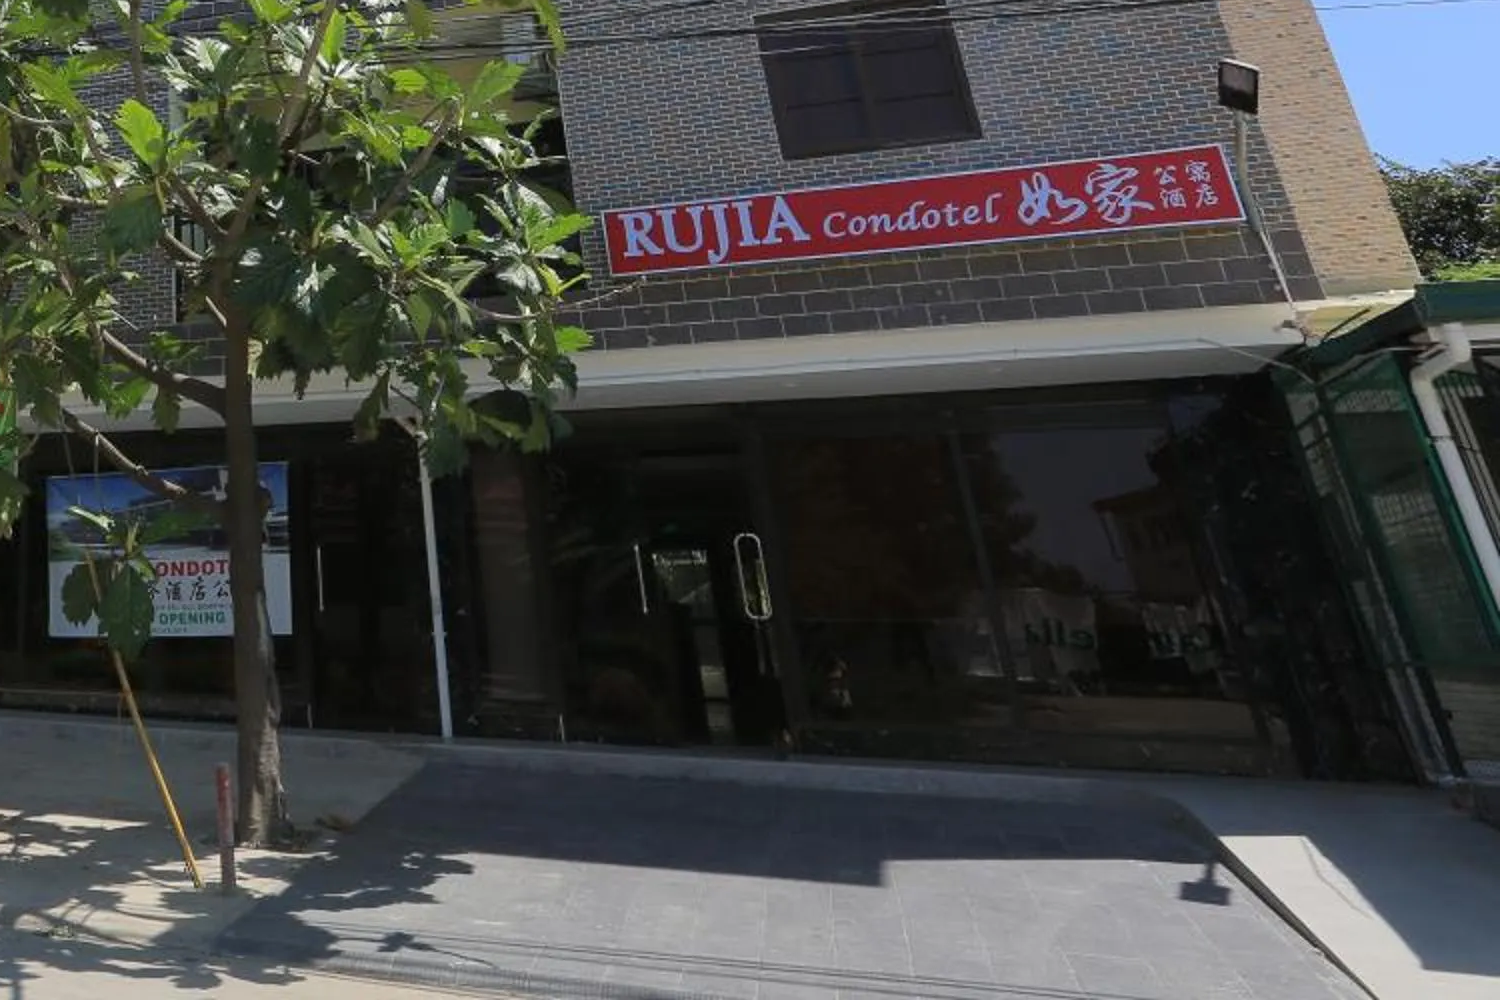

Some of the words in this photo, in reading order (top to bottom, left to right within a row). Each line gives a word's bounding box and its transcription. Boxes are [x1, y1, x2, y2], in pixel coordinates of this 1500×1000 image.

[619, 196, 810, 264] RUJIA
[822, 194, 1002, 238] Condotel
[1017, 164, 1154, 225] 如家
[156, 560, 229, 577] ONDOT
[159, 611, 225, 625] OPENING
